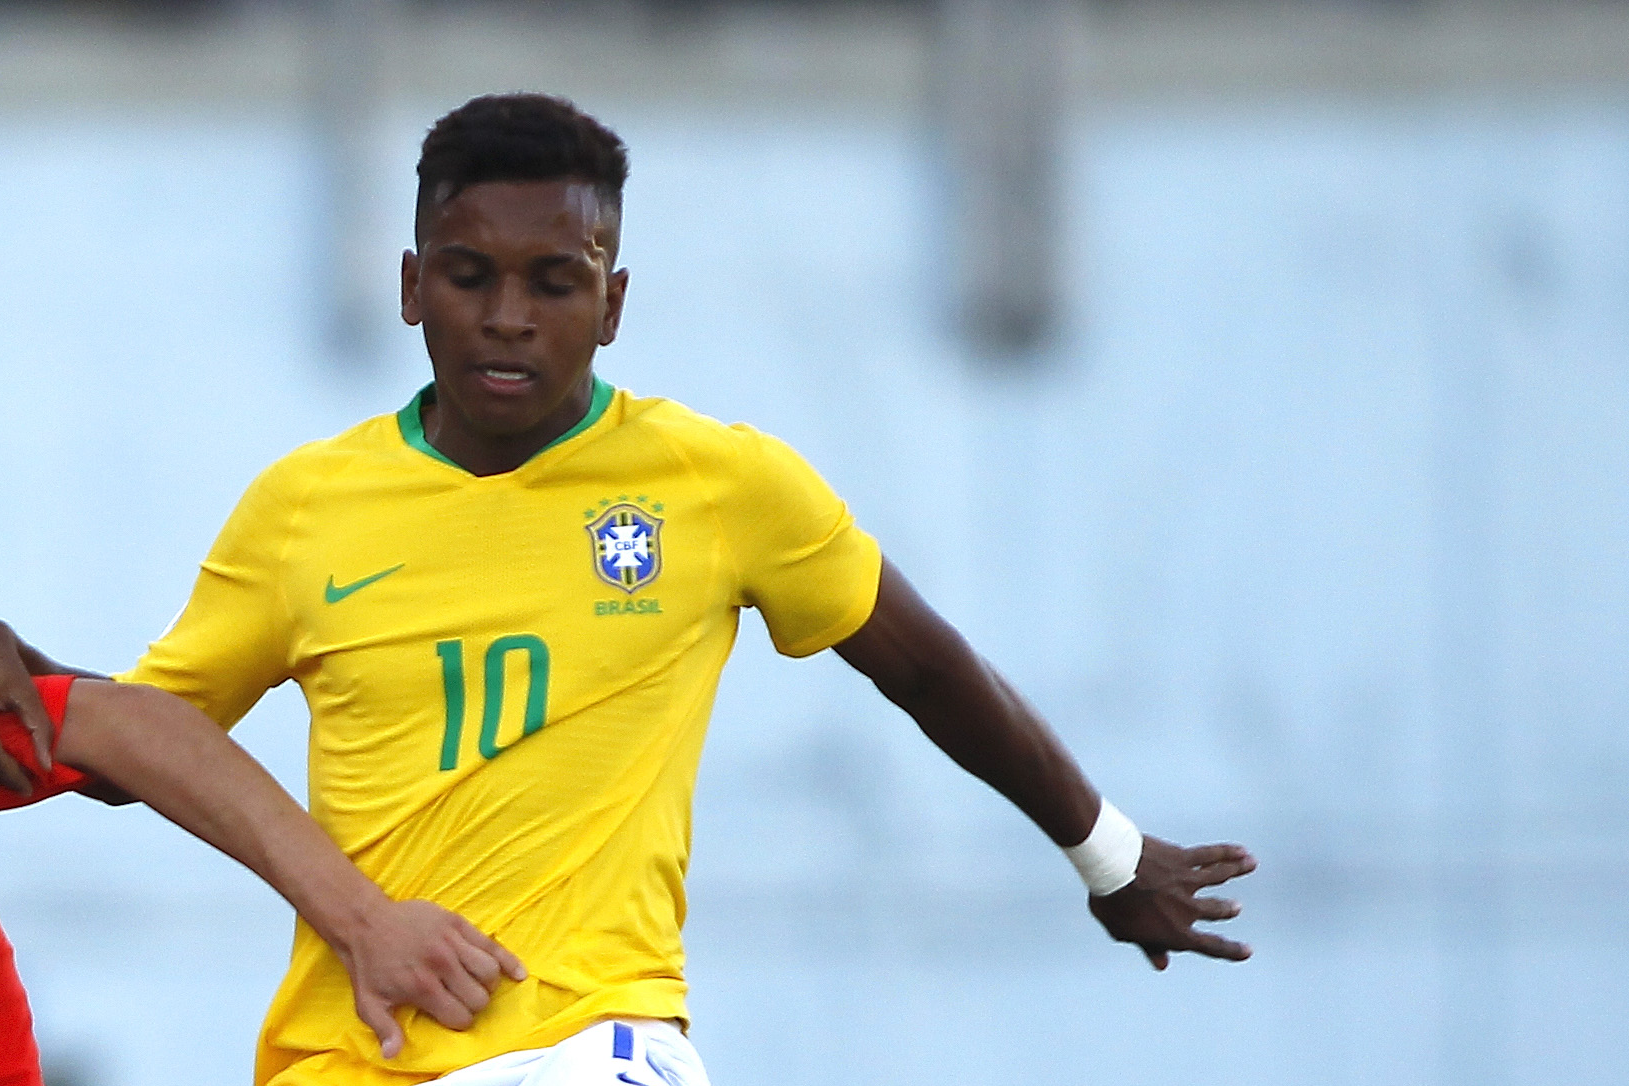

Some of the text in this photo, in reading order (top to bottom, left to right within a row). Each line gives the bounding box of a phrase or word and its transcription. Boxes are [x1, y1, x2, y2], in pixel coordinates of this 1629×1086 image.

[614, 540, 639, 551] CBF
[594, 599, 663, 615] BRASIL
[436, 634, 549, 770] 10
